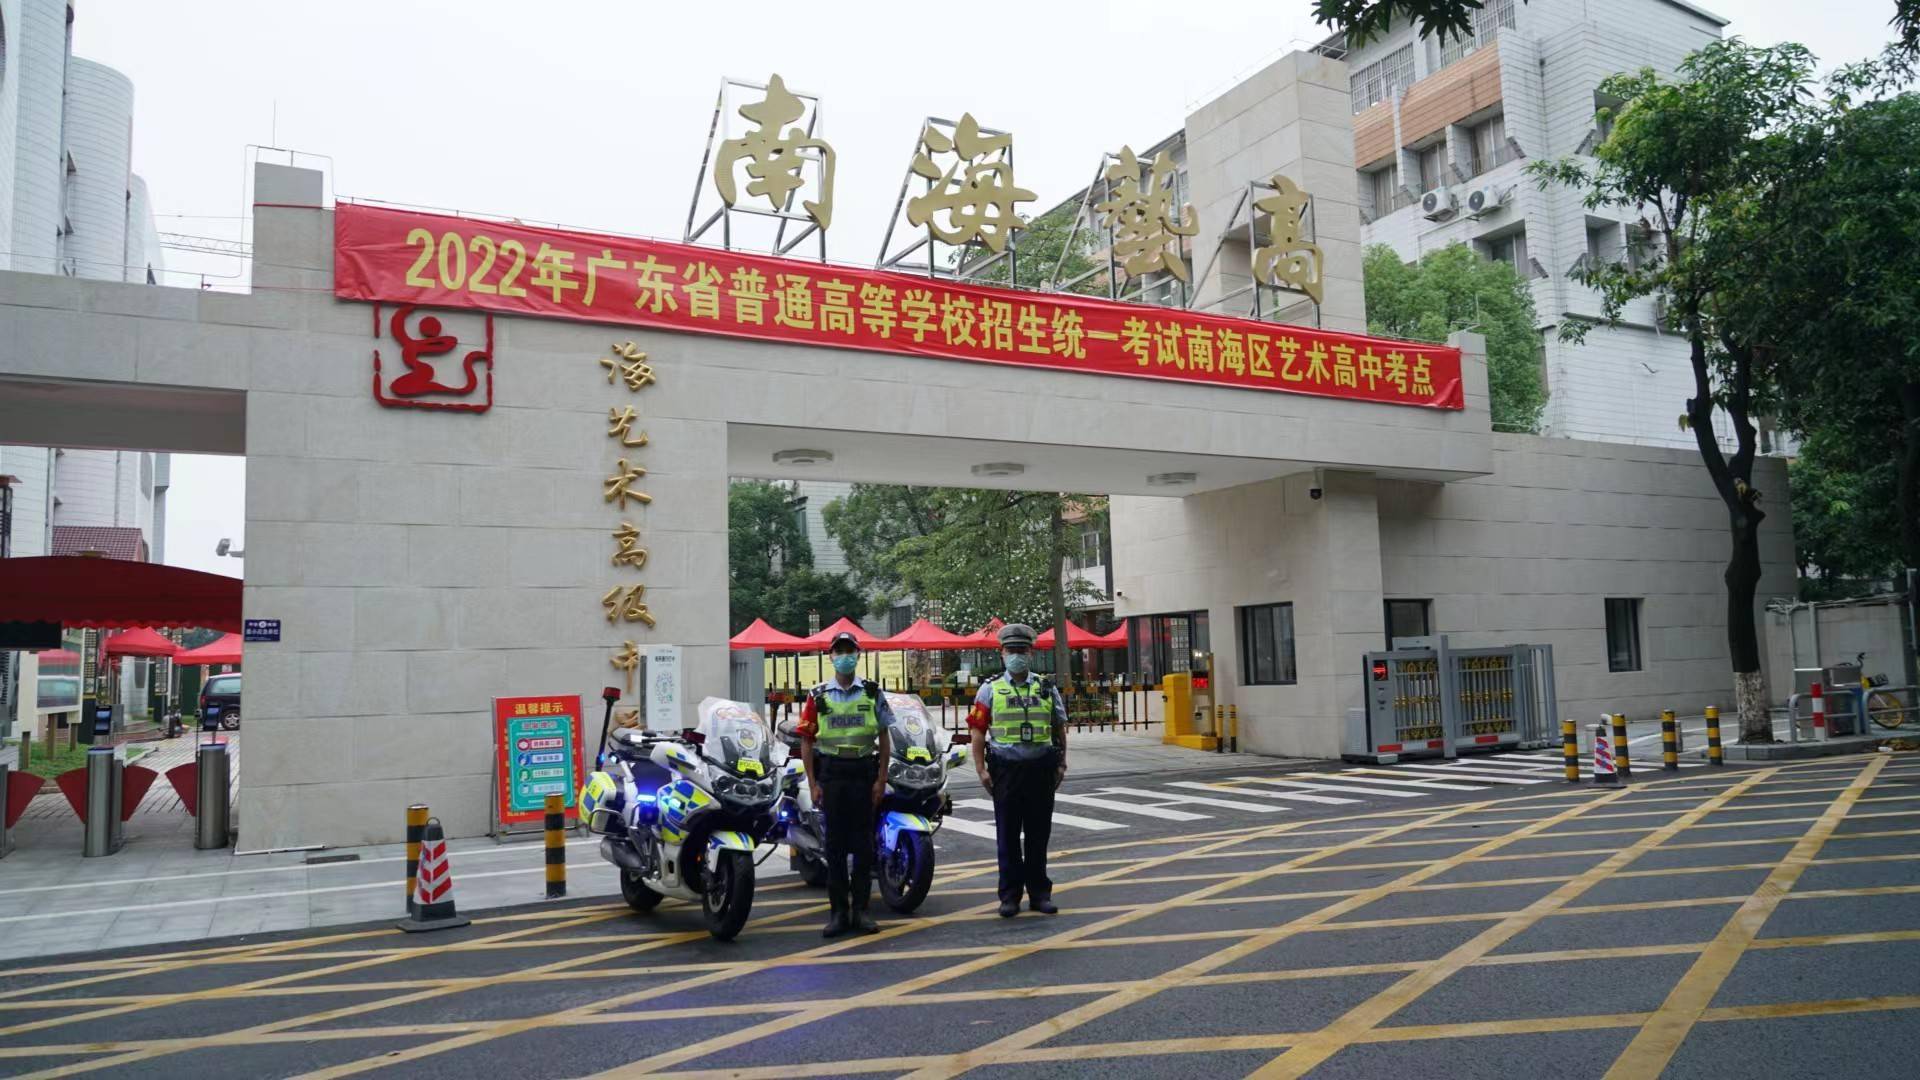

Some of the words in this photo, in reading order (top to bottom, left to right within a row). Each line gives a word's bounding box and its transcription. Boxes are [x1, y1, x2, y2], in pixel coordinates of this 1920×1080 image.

[404, 227, 1436, 397] 2022年广东省普通高等学校招生统一考试南海区艺术高中考点
[830, 715, 864, 728] POLICE
